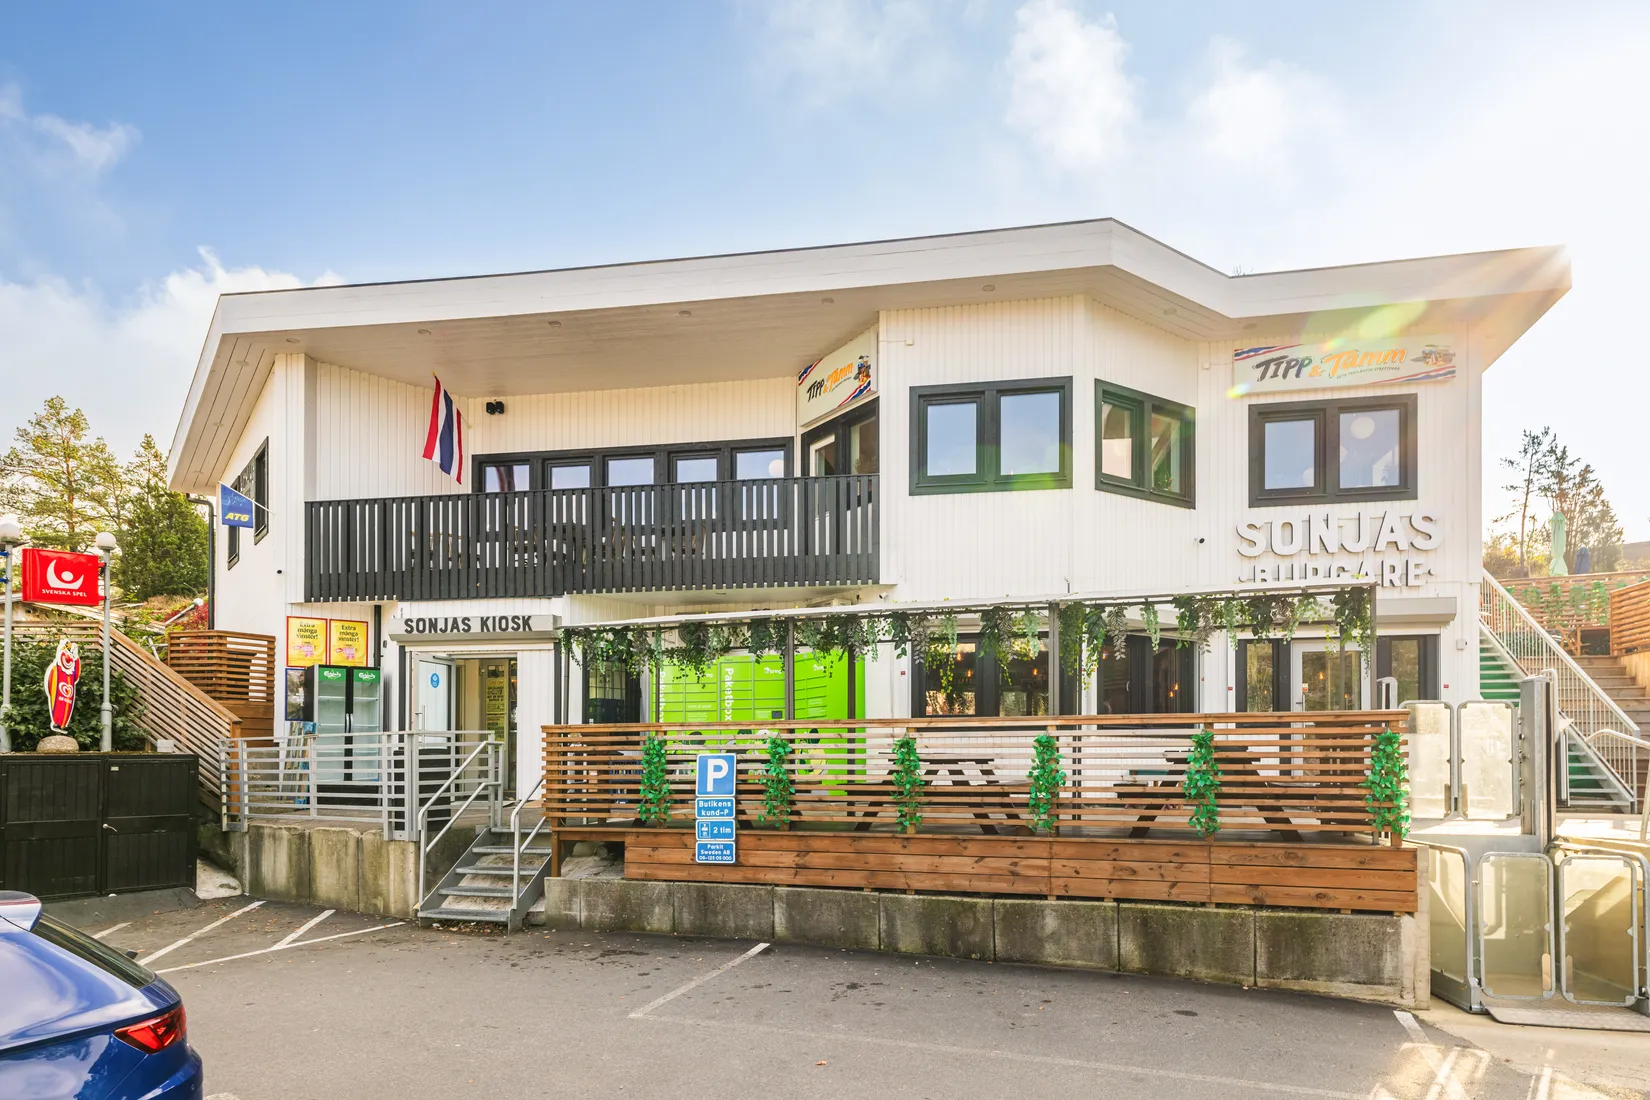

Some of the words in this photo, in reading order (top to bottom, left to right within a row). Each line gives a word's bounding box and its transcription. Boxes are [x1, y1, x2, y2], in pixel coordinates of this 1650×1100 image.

[1252, 354, 1313, 382] TIPP
[1308, 365, 1325, 377] &
[807, 378, 825, 402] TIPP
[225, 512, 249, 522] ATG
[1236, 510, 1443, 557] SONJAS
[42, 588, 71, 596] SVENSKA
[404, 617, 471, 634] SONJAS
[480, 615, 532, 632] KIOSK
[725, 667, 734, 721] Paketbox
[707, 759, 729, 792] P
[713, 826, 718, 834] 2
[720, 826, 732, 834] tim
